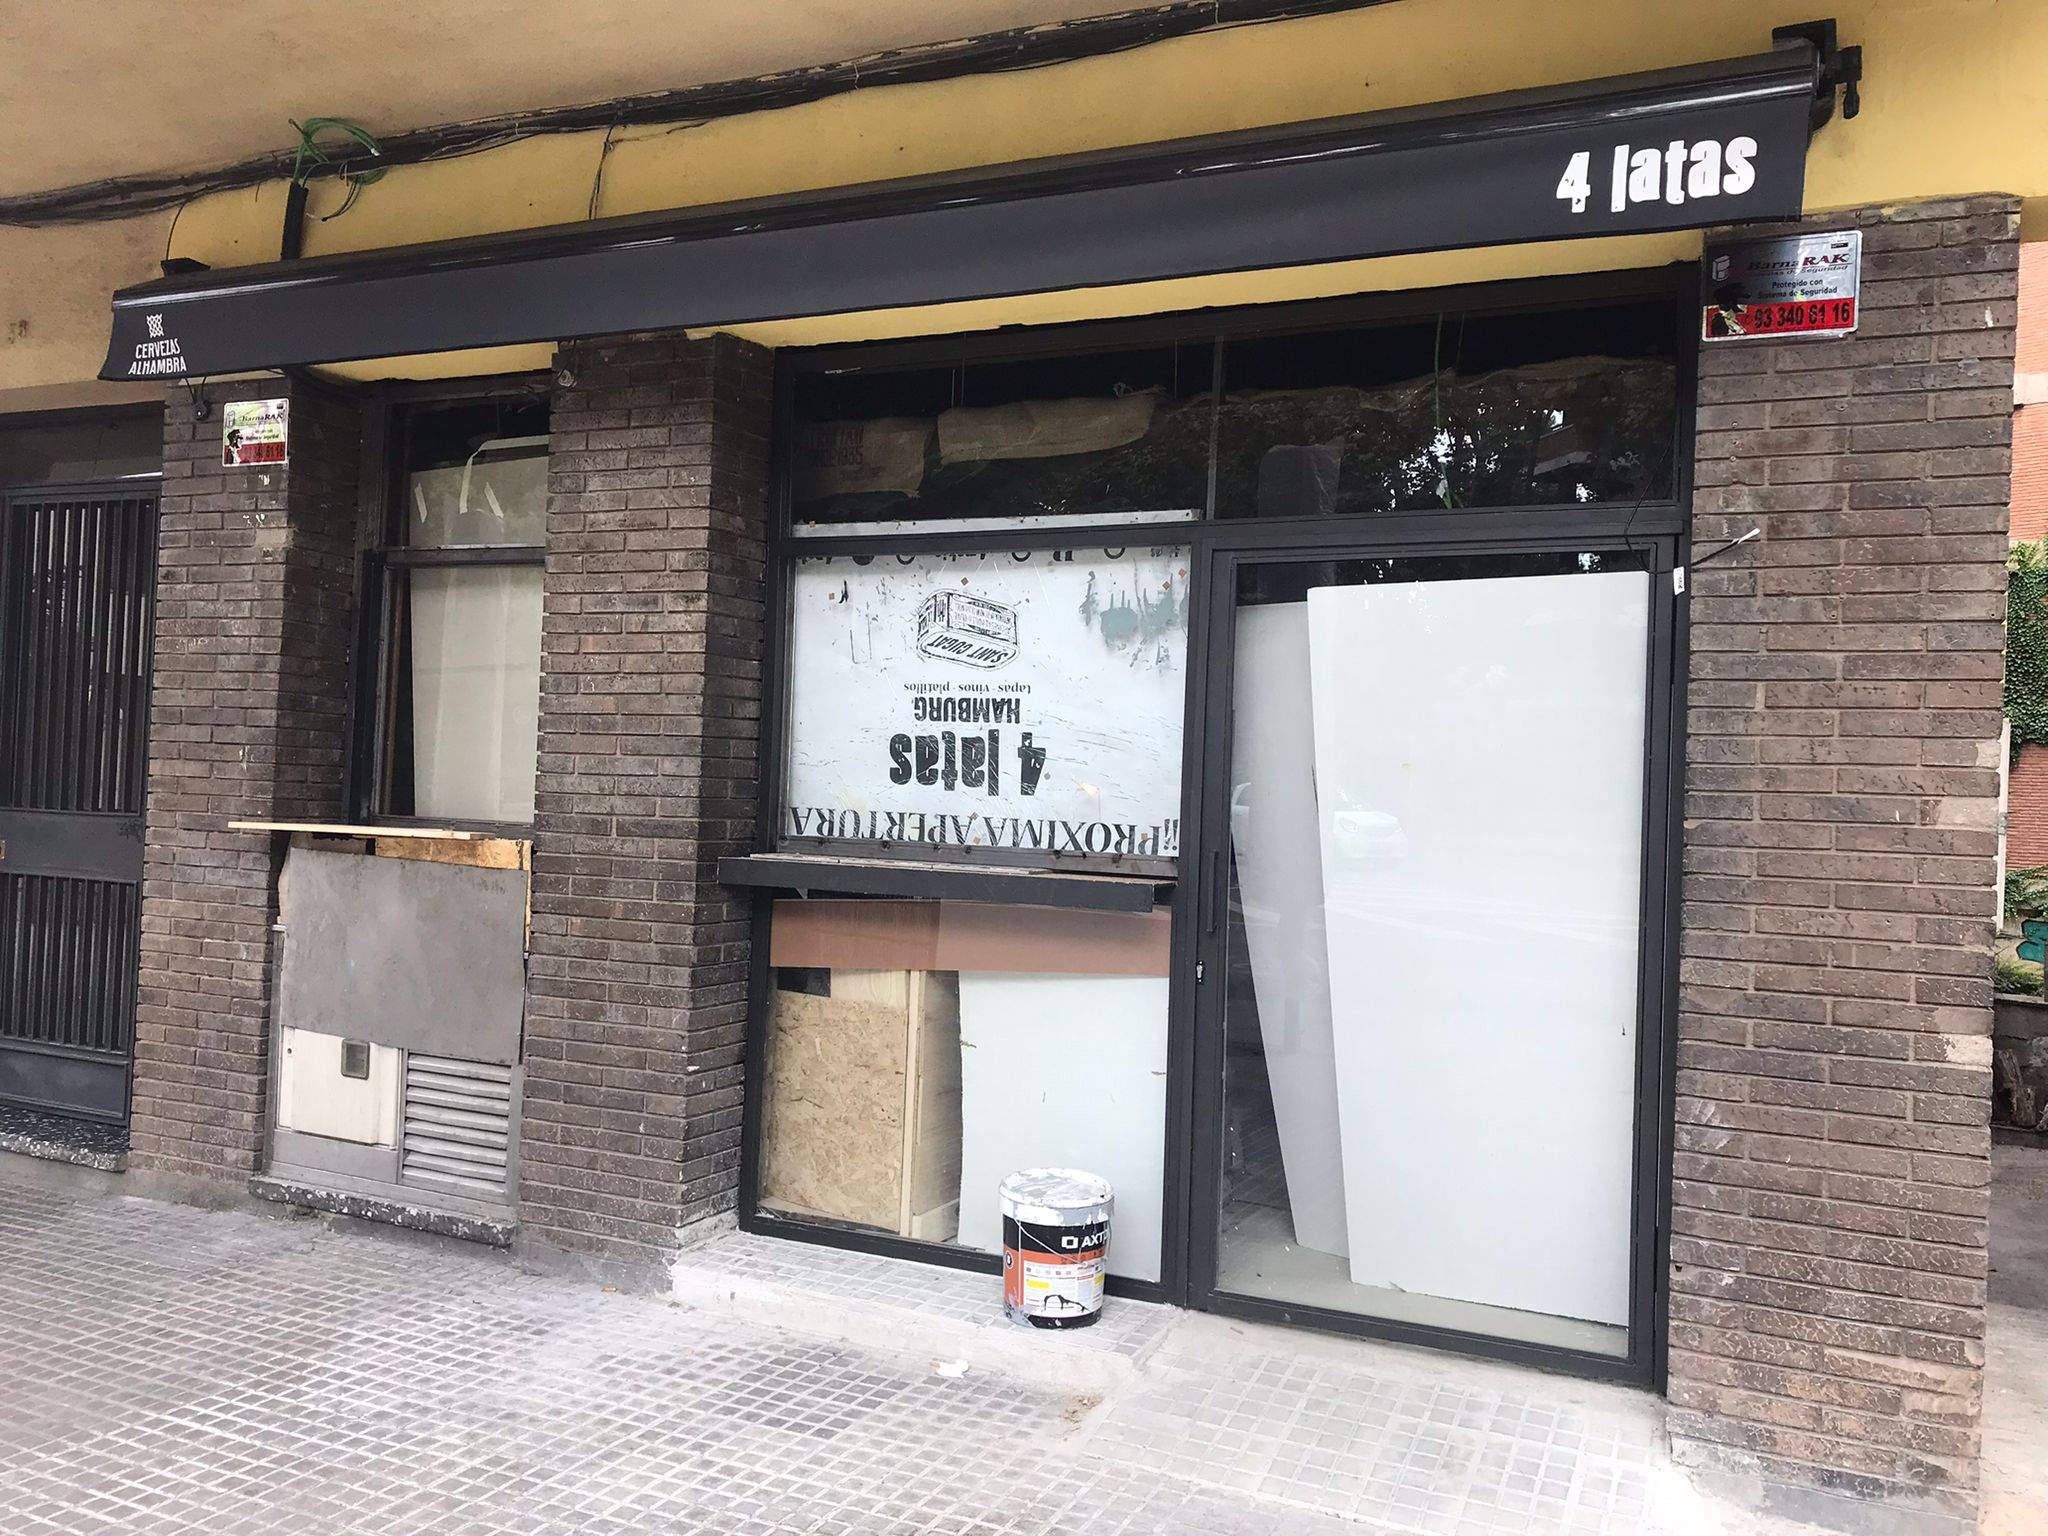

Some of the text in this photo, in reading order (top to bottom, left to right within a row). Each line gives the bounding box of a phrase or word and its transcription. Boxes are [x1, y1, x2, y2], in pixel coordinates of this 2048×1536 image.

[1556, 136, 1758, 213] 4 latas
[1772, 278, 1824, 290] Protegido con
[1800, 286, 1838, 297] Seguridad
[1754, 302, 1850, 329] 93 340 61 16
[135, 338, 181, 359] CERVEZAS
[128, 356, 187, 375] ALHAMBRA
[927, 634, 1009, 664] SANT CUGAT
[903, 681, 1031, 695] tapas vinos platillos
[914, 696, 1021, 725] HAMBURG
[889, 728, 1047, 797] 4 latas
[789, 806, 975, 846] APERTURA
